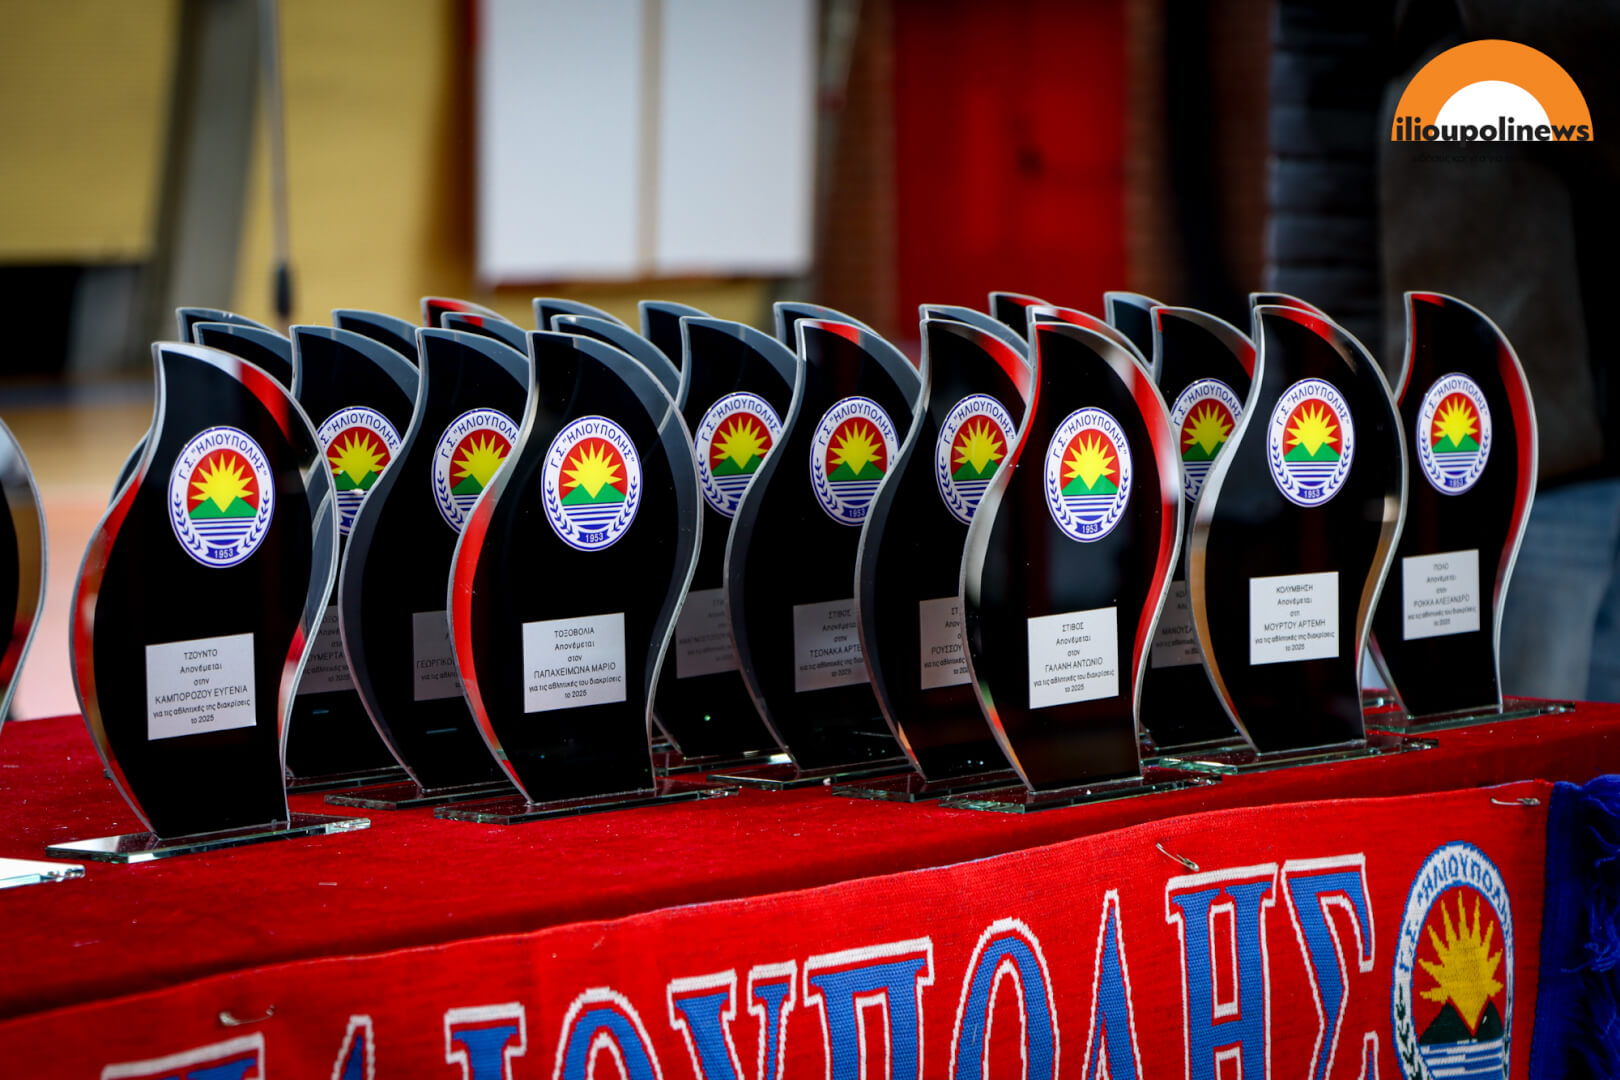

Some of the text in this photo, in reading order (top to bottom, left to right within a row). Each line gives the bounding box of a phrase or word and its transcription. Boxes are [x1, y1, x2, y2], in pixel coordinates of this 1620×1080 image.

[1184, 385, 1242, 419] "ΗΛΙΟΥΠΟΛΗΣ
[320, 434, 332, 448] .Σ.
[1082, 524, 1098, 534] 1953
[586, 532, 604, 543] 1953
[214, 548, 234, 559] 1953
[1276, 584, 1313, 594] ΚΟΛΥΜΒΗΣΗ
[1277, 597, 1312, 606] Απονέμεται
[1062, 622, 1084, 632] ΣΤΙΒΟΣ
[1264, 618, 1326, 631] ΜΟΥΡΤΟΥ ΑΡΤΕΜΗ
[554, 627, 595, 638] ΤΟΞΟΒΟΛΙΑ
[555, 640, 595, 651] Απονέμεται
[1056, 635, 1091, 646] Απονέμεται
[184, 649, 218, 660] ΤΖΟΥΝΤΟ
[844, 644, 862, 654] ΑΡΤΕ
[180, 663, 222, 674] Απονέμεται
[1045, 656, 1103, 673] ΓΑΛΑΝΗ ΑΝΤΩΝΙΟ
[534, 662, 616, 679] ΠΑΠΑΧΕΙΜΩΝΑ ΜΑΡΙΟ
[194, 678, 209, 686] στην
[1050, 675, 1076, 685] αθλητικές
[1086, 669, 1114, 679] διακρίσεις
[548, 680, 578, 690] αθλητικές
[590, 676, 622, 685] διακρίσεις
[1071, 684, 1084, 692] 2025
[155, 685, 248, 704] ΚΑΜΠΟΡΟΖΟΥ ΕΥΓΕΝΙΑ
[153, 711, 163, 719] για
[164, 709, 173, 717] τις
[174, 704, 205, 715] αθλητικές
[217, 699, 251, 709] διακρίσεις
[198, 714, 214, 724] 2025
[101, 852, 1380, 1080] ΠΟΛΗΣ
